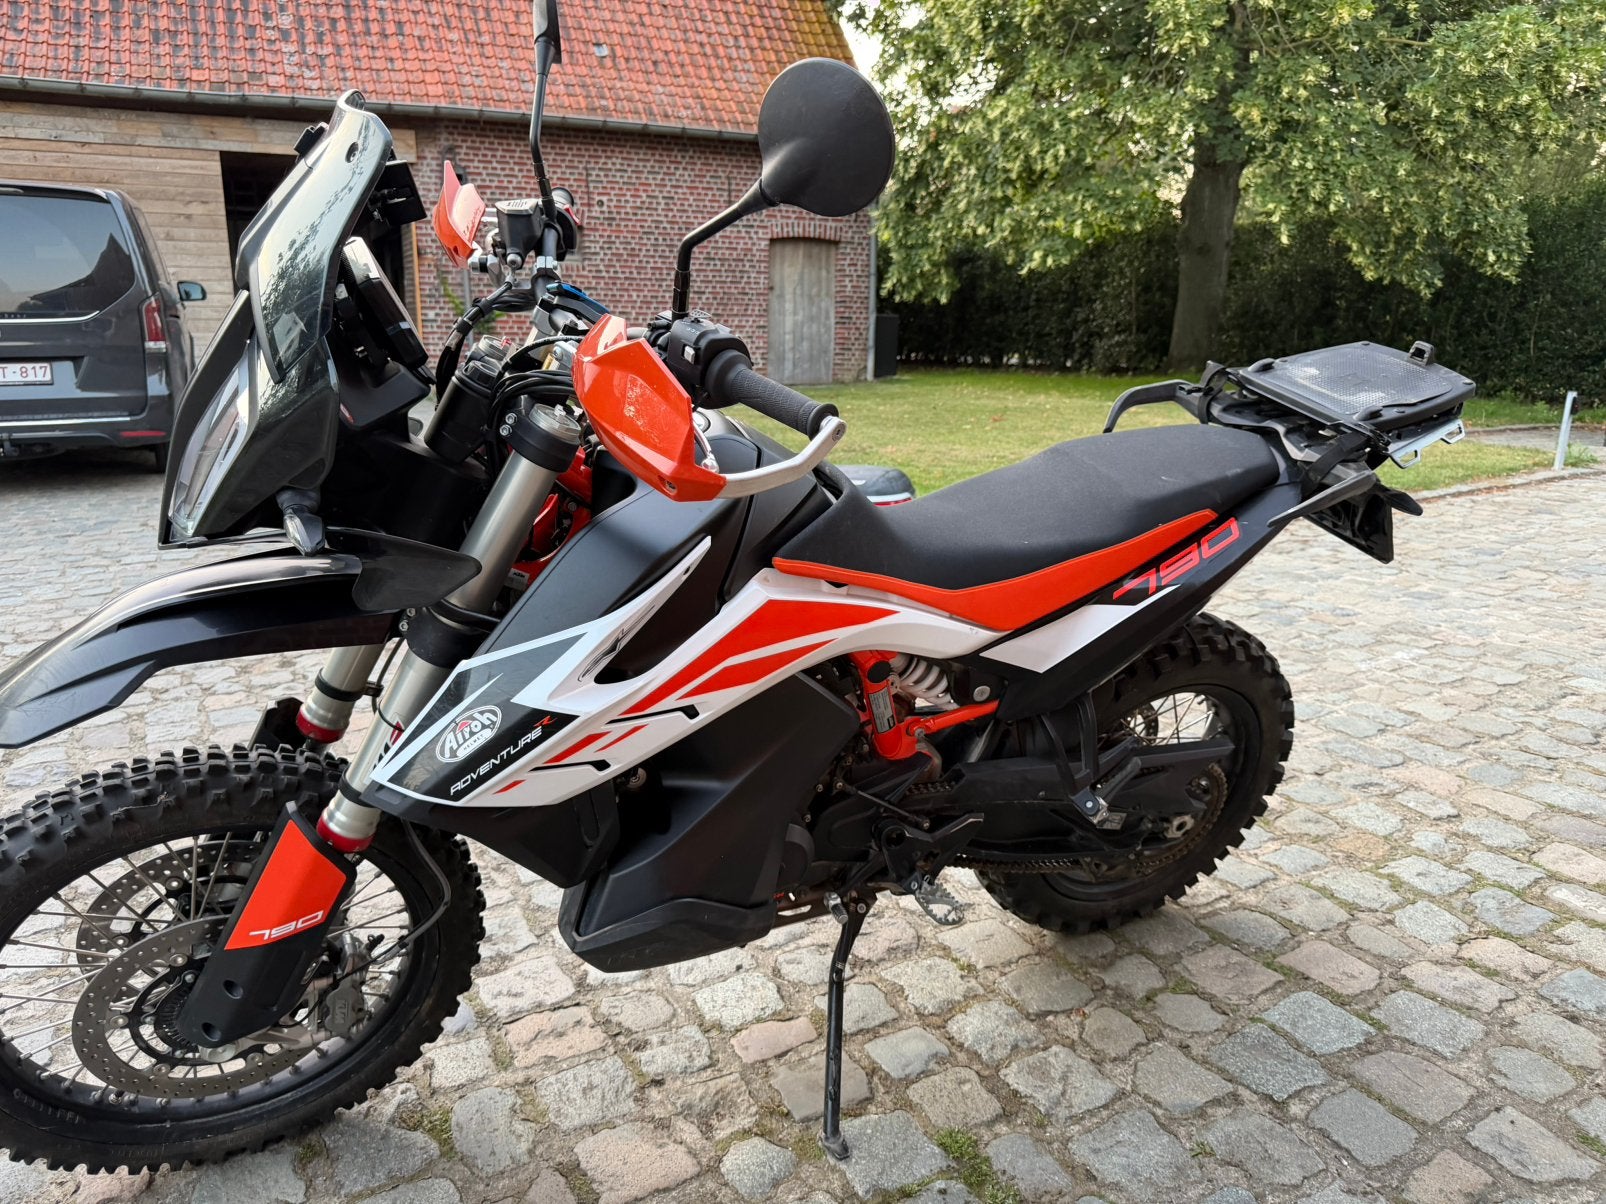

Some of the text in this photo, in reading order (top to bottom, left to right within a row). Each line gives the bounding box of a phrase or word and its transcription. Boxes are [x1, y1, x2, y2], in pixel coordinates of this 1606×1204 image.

[1113, 517, 1240, 600] 790
[450, 726, 542, 796] ADVENTURE
[249, 910, 324, 940] 790
